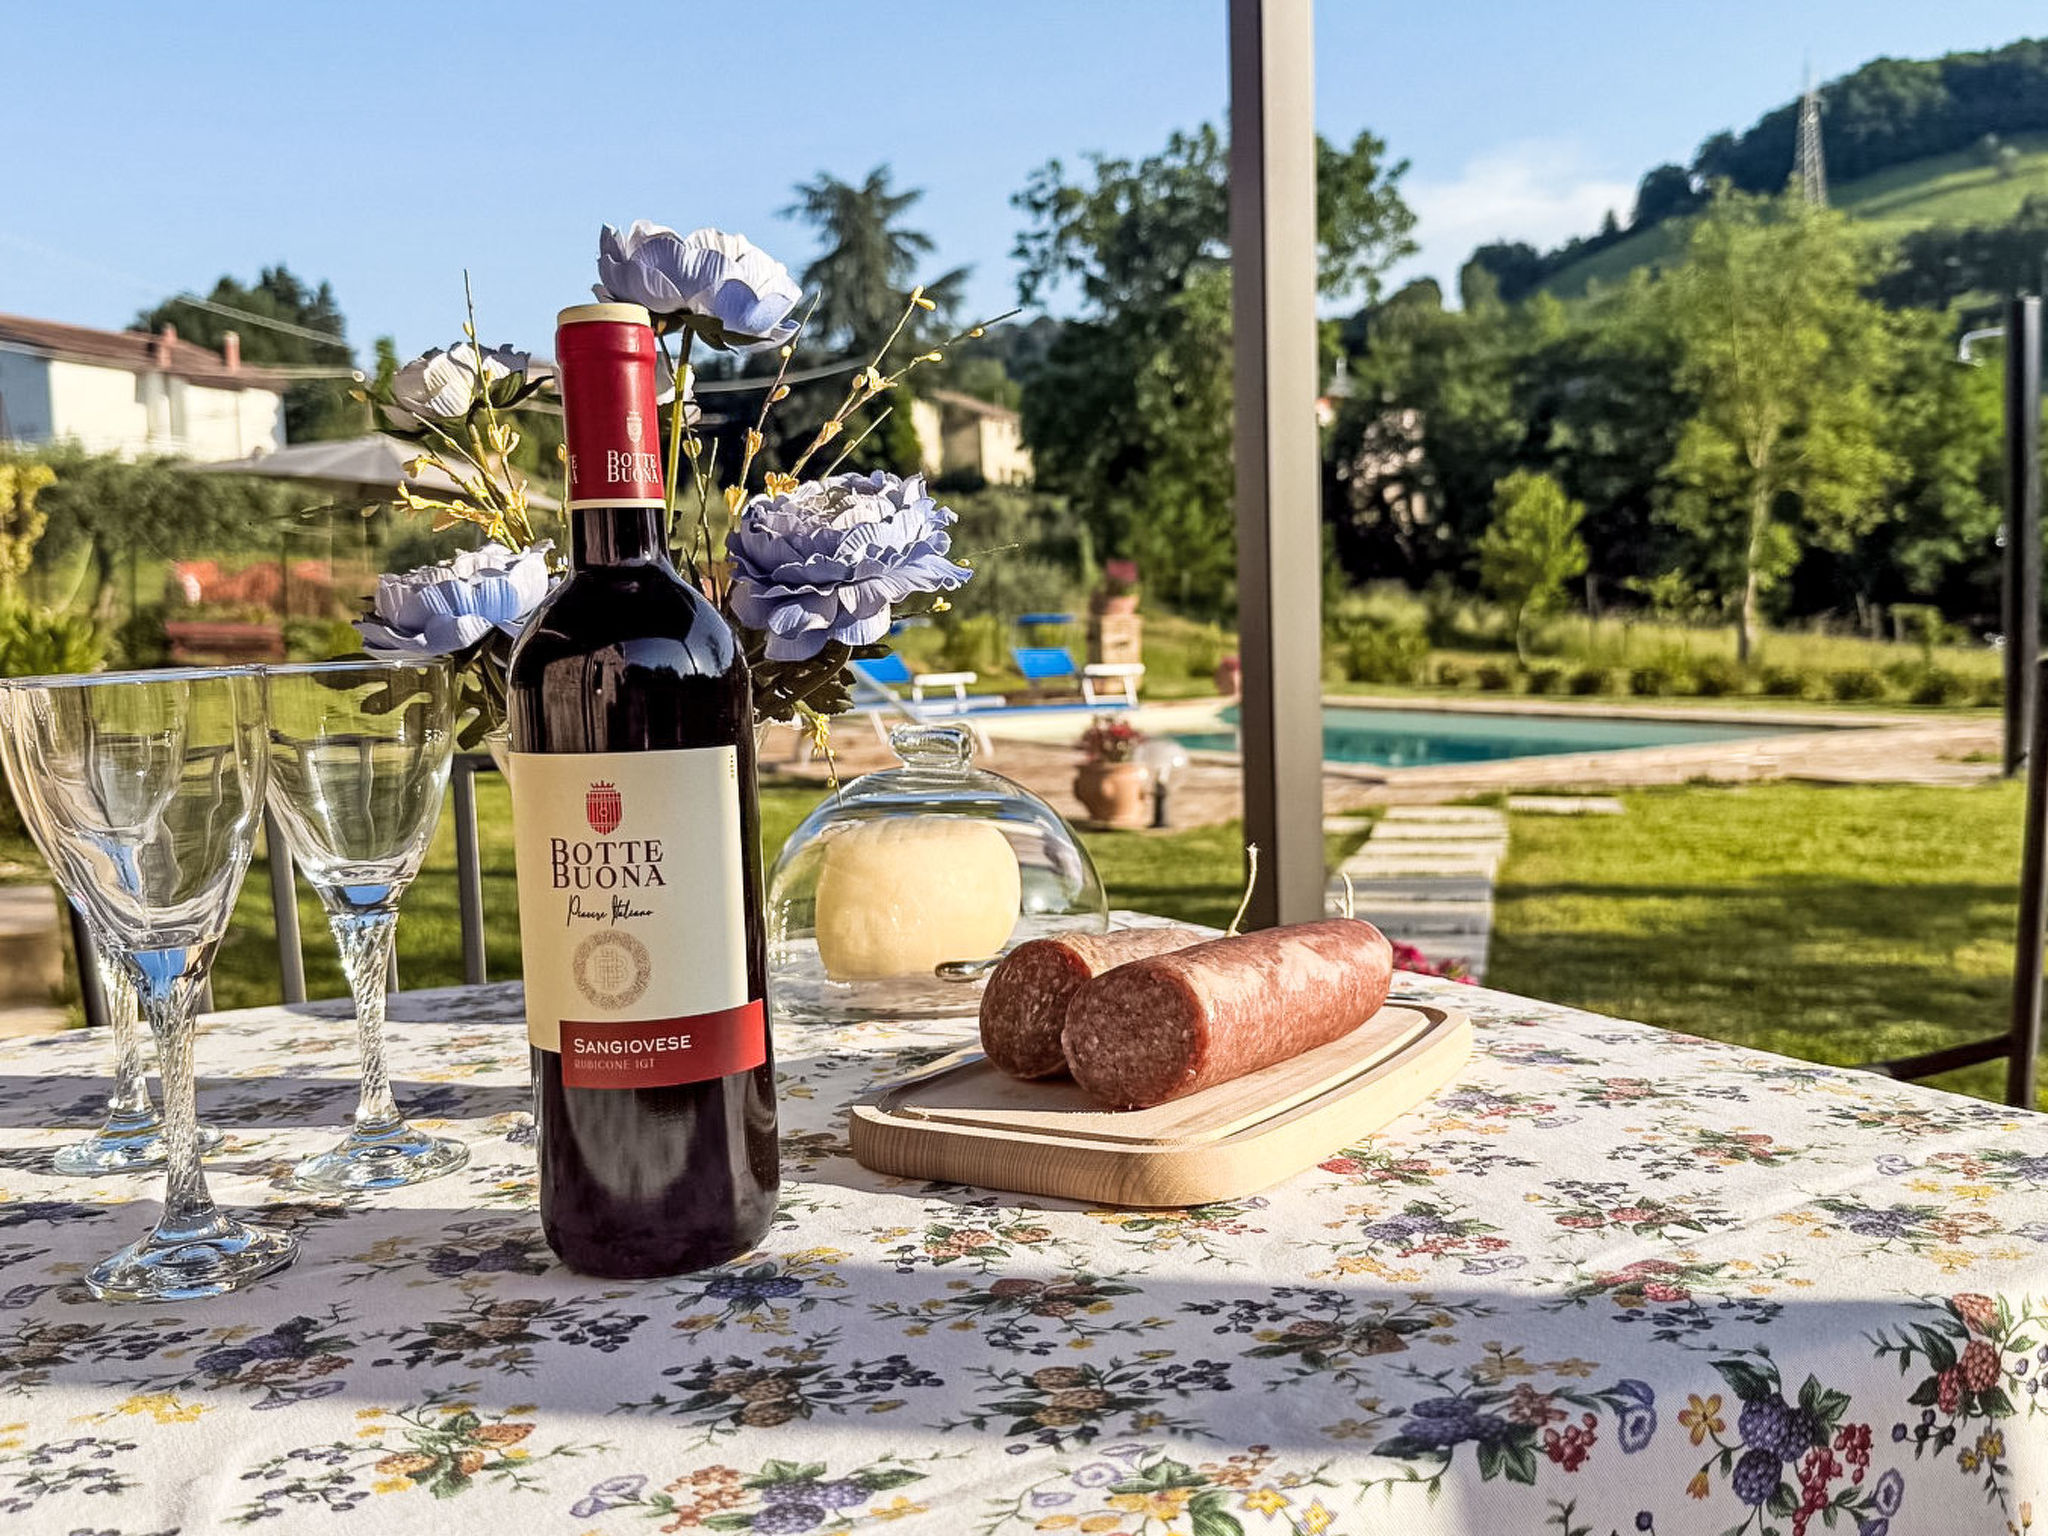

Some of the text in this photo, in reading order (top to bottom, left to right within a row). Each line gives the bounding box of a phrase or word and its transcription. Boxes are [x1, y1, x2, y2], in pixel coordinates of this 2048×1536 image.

[607, 449, 657, 469] BOTTE
[607, 465, 660, 484] BUONA
[550, 837, 664, 866] BOTTE
[552, 862, 667, 890] BUONA
[574, 1034, 692, 1055] SANGIOVESE
[574, 1059, 631, 1070] RUBICONE
